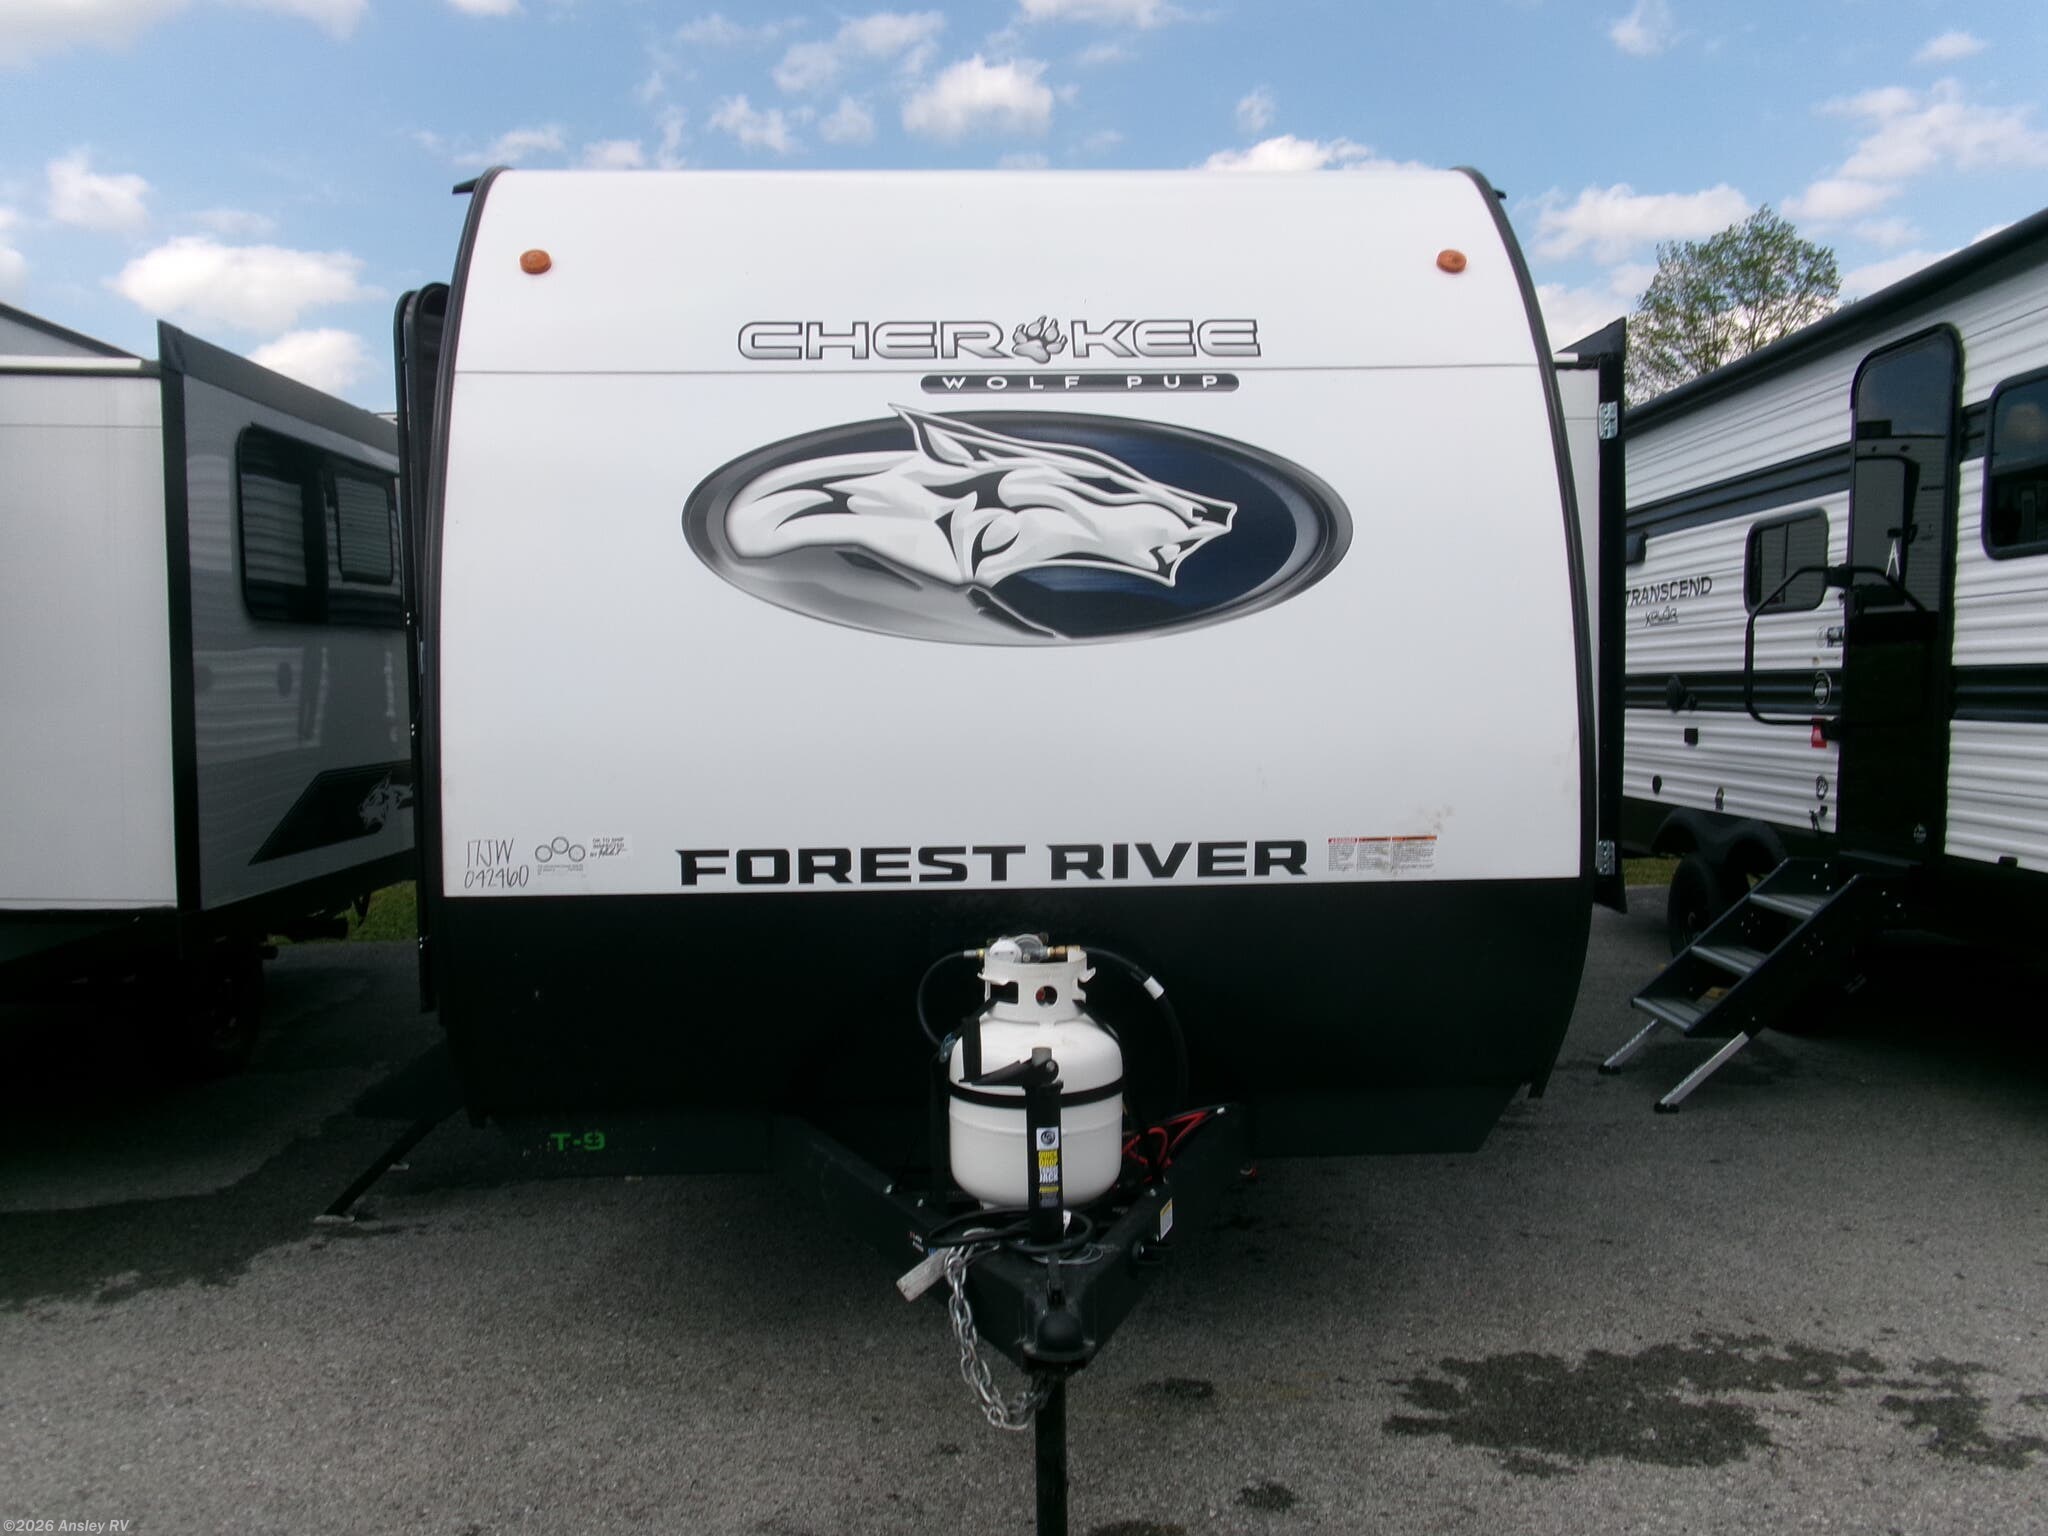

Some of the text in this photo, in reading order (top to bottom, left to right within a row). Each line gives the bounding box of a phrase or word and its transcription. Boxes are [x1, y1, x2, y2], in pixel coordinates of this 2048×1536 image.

[942, 374, 1218, 390] WOLF PUP
[1626, 576, 1713, 608] TRANSCEND
[675, 846, 1026, 886] FOREST
[1046, 839, 1308, 881] RIVER
